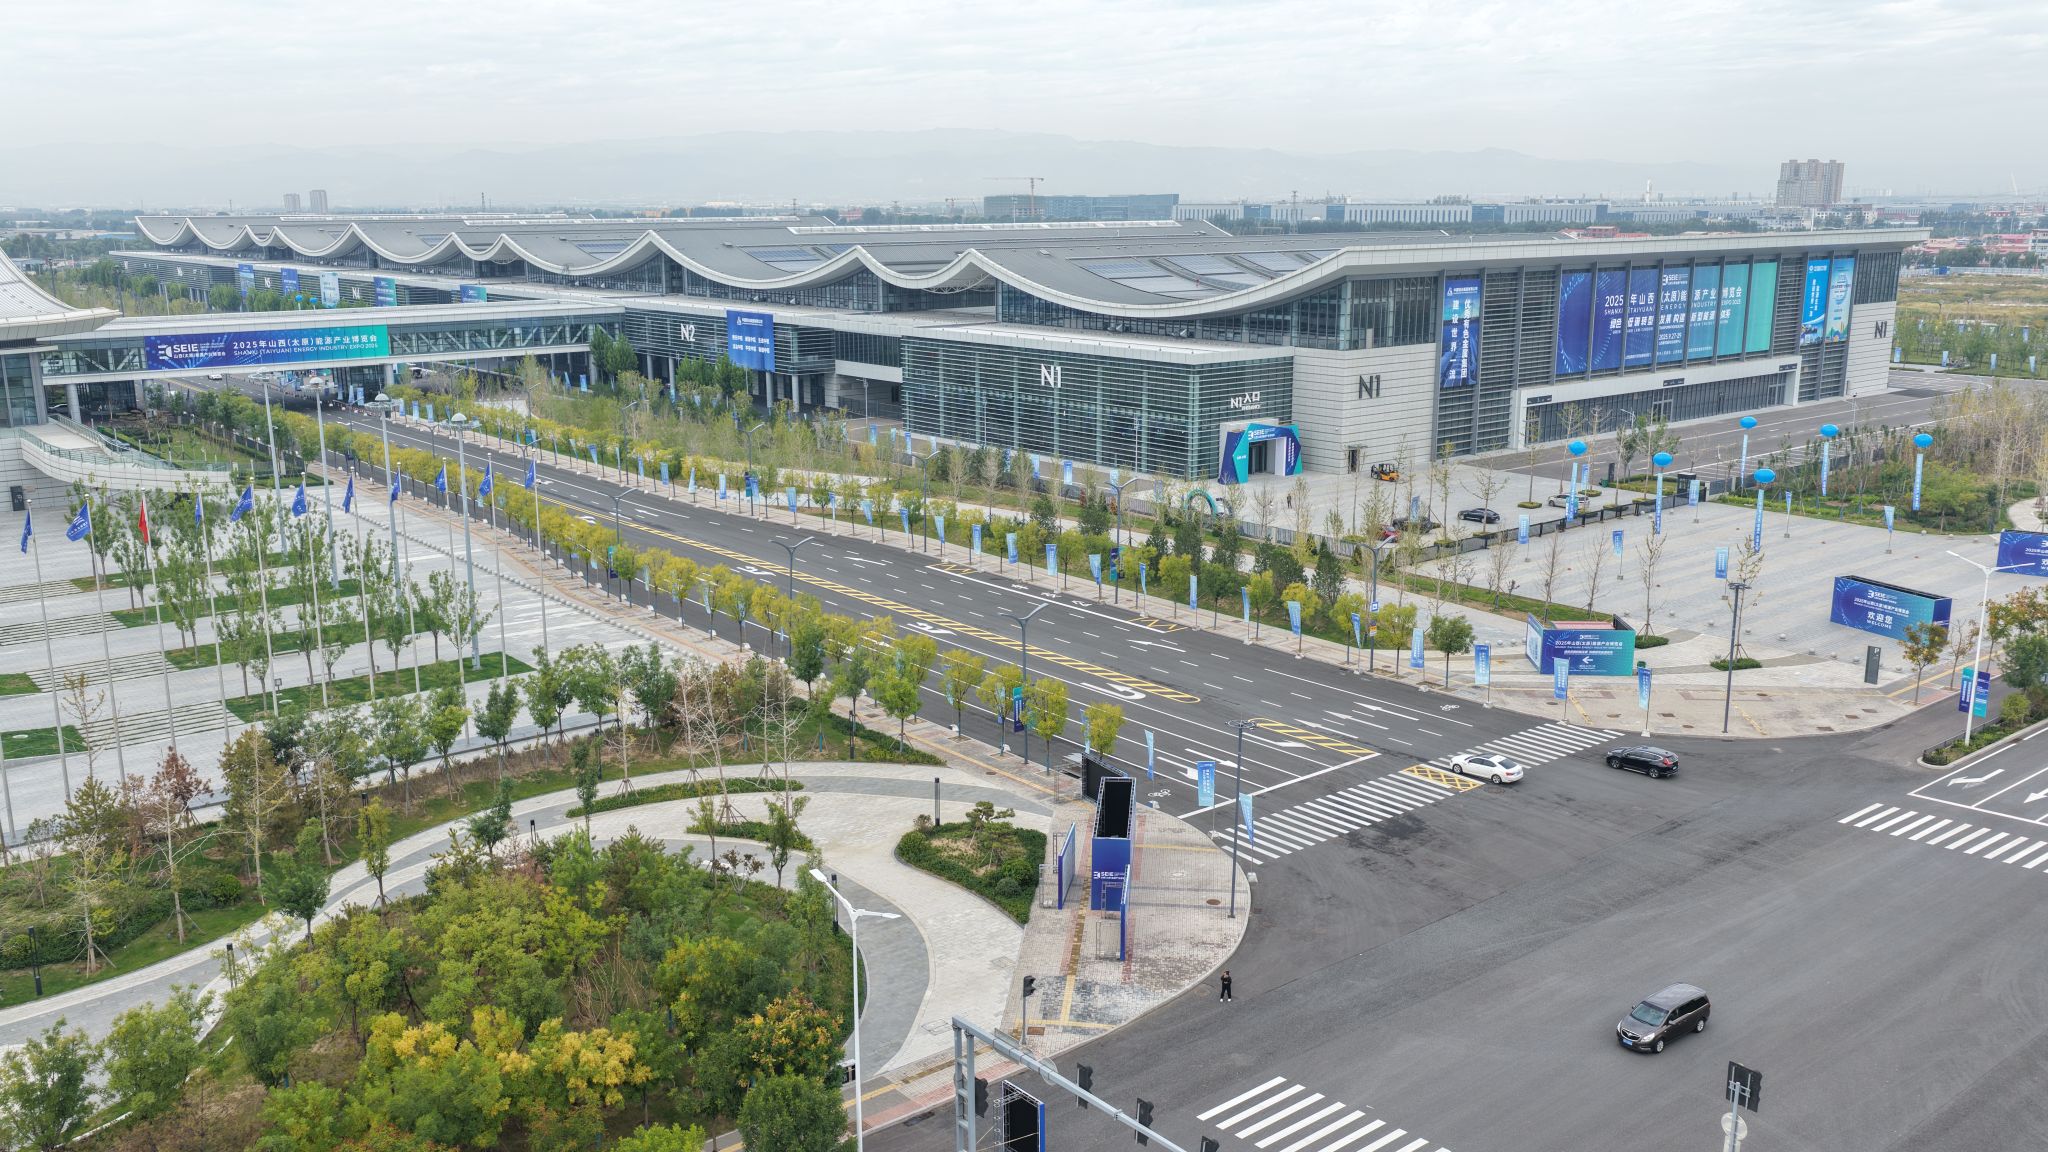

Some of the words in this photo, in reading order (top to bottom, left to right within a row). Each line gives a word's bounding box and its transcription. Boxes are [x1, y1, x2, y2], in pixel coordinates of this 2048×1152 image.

[680, 323, 696, 342] N2
[1874, 320, 1887, 339] N1
[173, 343, 199, 353] SEIE
[318, 344, 348, 352] INDUSTRY
[1449, 299, 1460, 380] 建设世界一流
[1041, 364, 1062, 388] N1
[1358, 374, 1380, 399] N1
[1230, 397, 1242, 408] N1
[1244, 392, 1260, 403] 入口
[1866, 619, 1892, 630] WELCOME
[1867, 611, 1893, 625] 欢迎您
